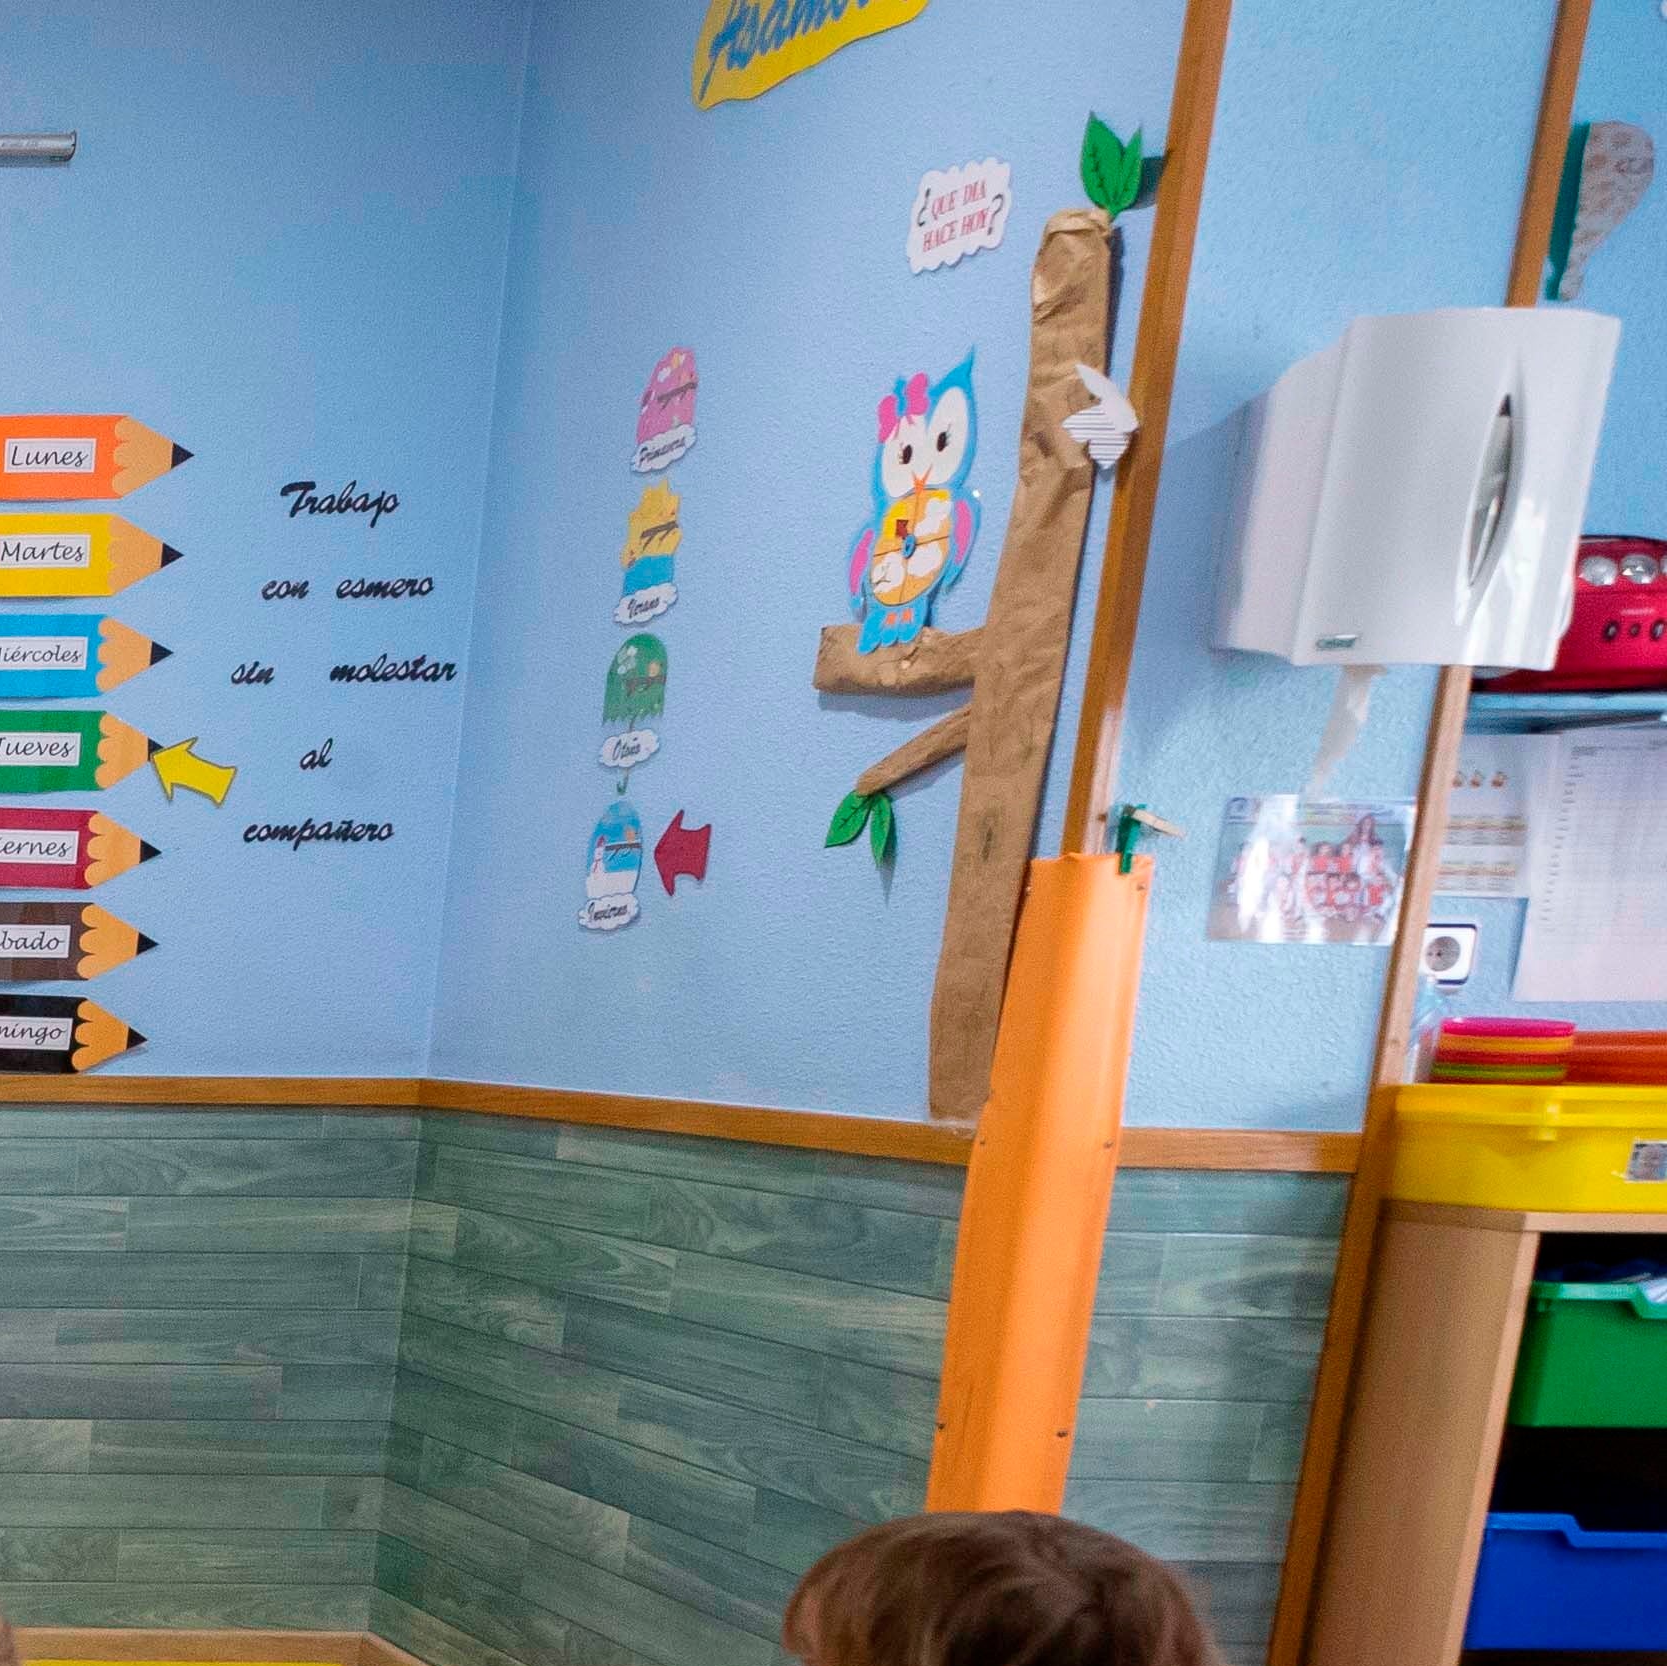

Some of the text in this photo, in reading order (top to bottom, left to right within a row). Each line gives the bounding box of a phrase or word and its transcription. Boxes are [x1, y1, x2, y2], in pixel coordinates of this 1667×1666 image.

[11, 445, 89, 468] Lunes
[280, 480, 400, 528] Trabajo
[0, 540, 85, 563] Martes
[261, 576, 435, 600] con esmero
[230, 653, 457, 684] sin molestar
[299, 737, 334, 770] al
[242, 817, 395, 851] compañero
